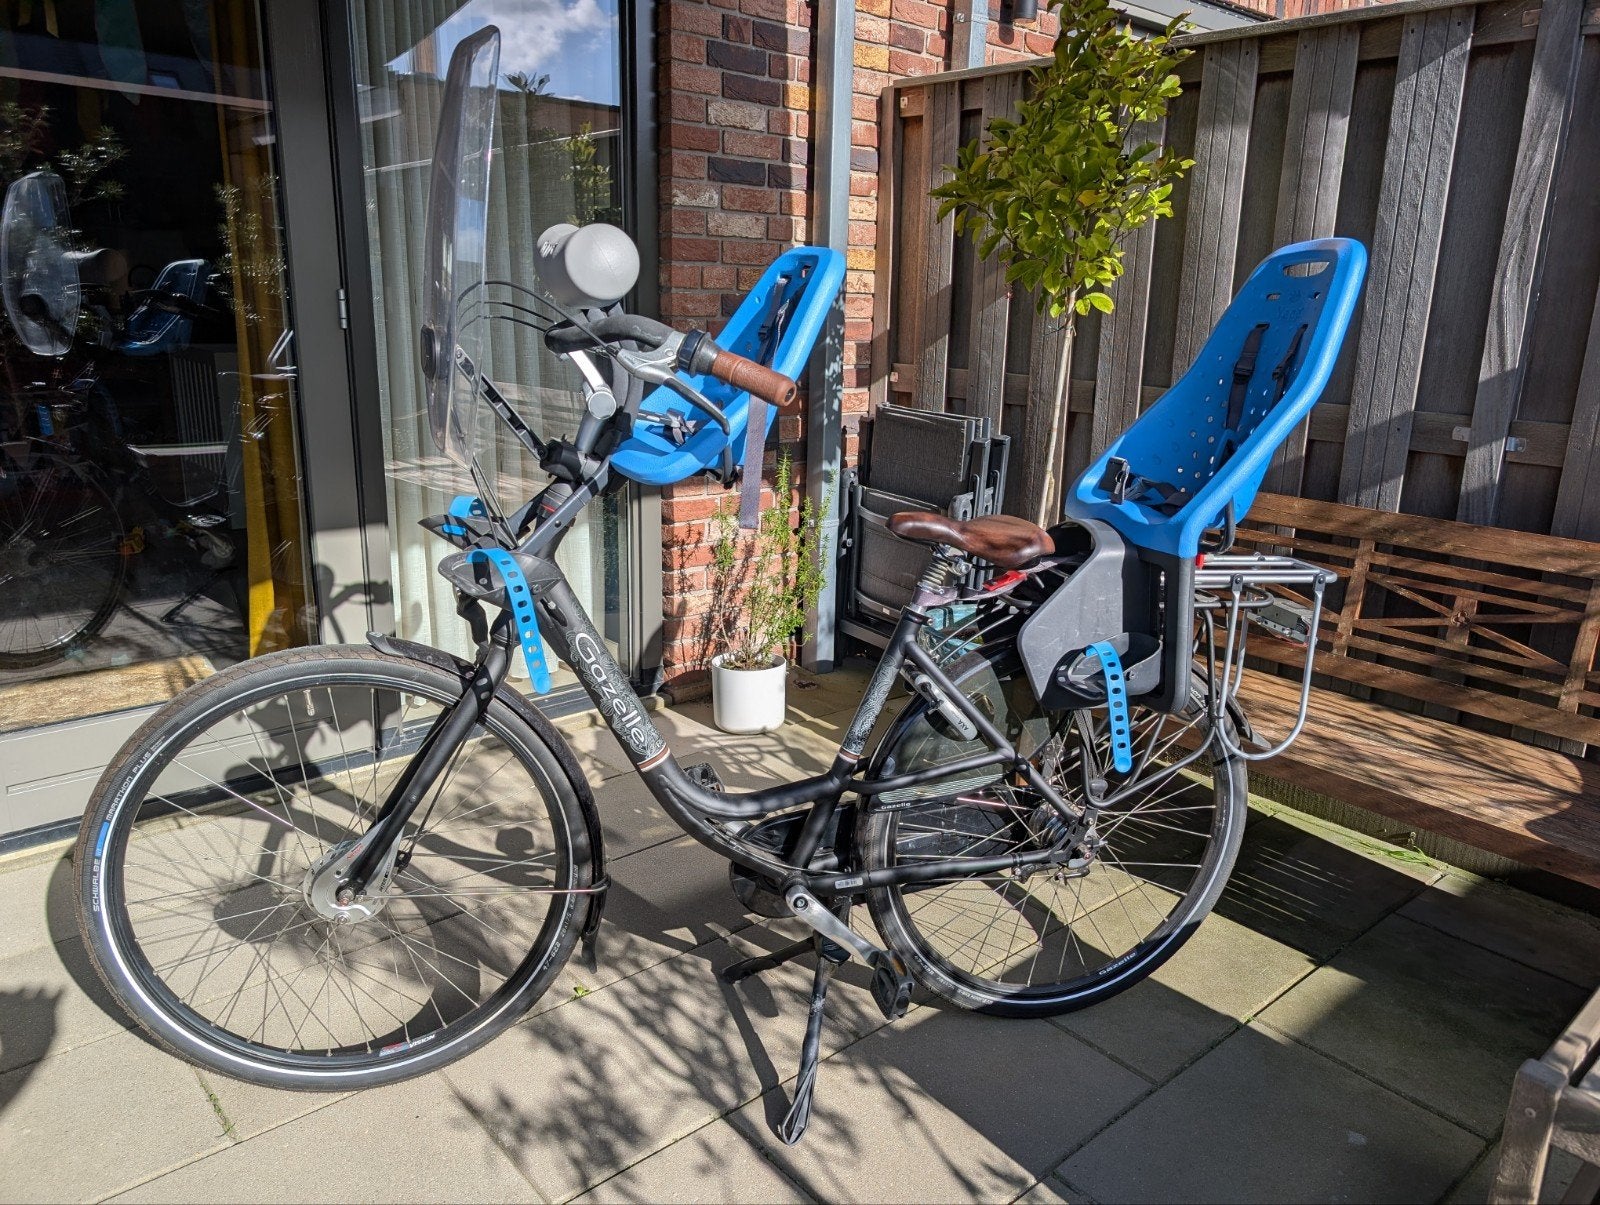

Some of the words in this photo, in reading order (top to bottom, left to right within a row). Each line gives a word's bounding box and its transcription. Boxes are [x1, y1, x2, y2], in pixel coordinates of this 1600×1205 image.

[575, 633, 645, 745] Gazelle
[957, 719, 969, 731] AXA
[106, 776, 133, 822] MARATHON
[132, 750, 152, 774] PLUS
[880, 802, 911, 810] Gazelle
[92, 857, 101, 913] SCHWALBE
